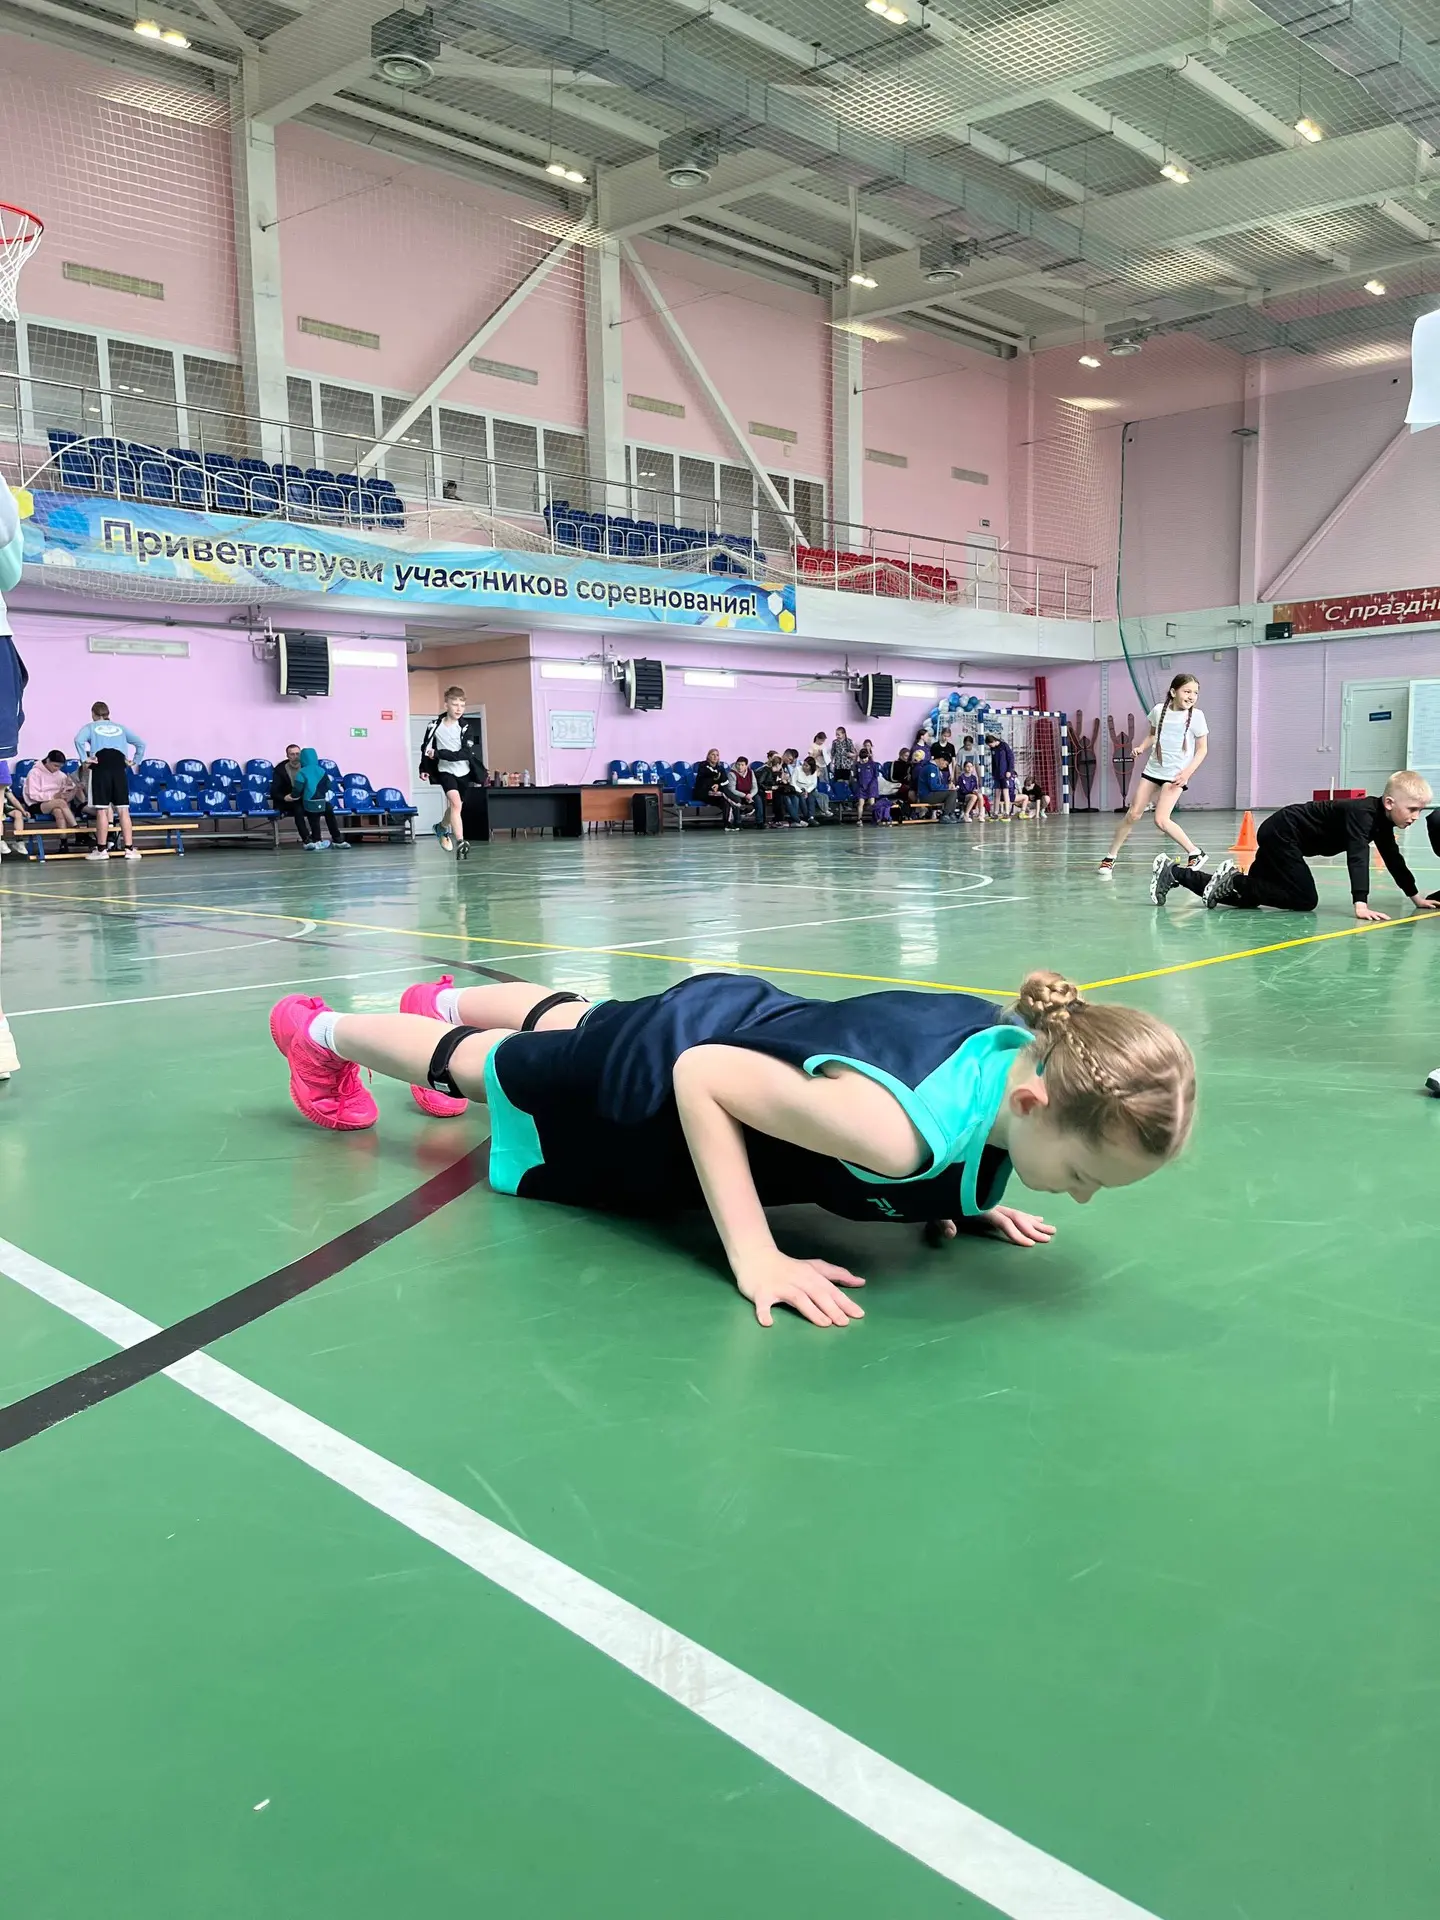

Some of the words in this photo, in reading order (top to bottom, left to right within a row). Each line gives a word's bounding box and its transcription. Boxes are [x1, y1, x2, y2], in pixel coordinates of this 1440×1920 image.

[103, 519, 384, 583] Приветствуем
[394, 564, 568, 597] участников
[576, 580, 757, 616] соревнования!
[1325, 606, 1343, 621] С
[1348, 598, 1440, 621] праздн
